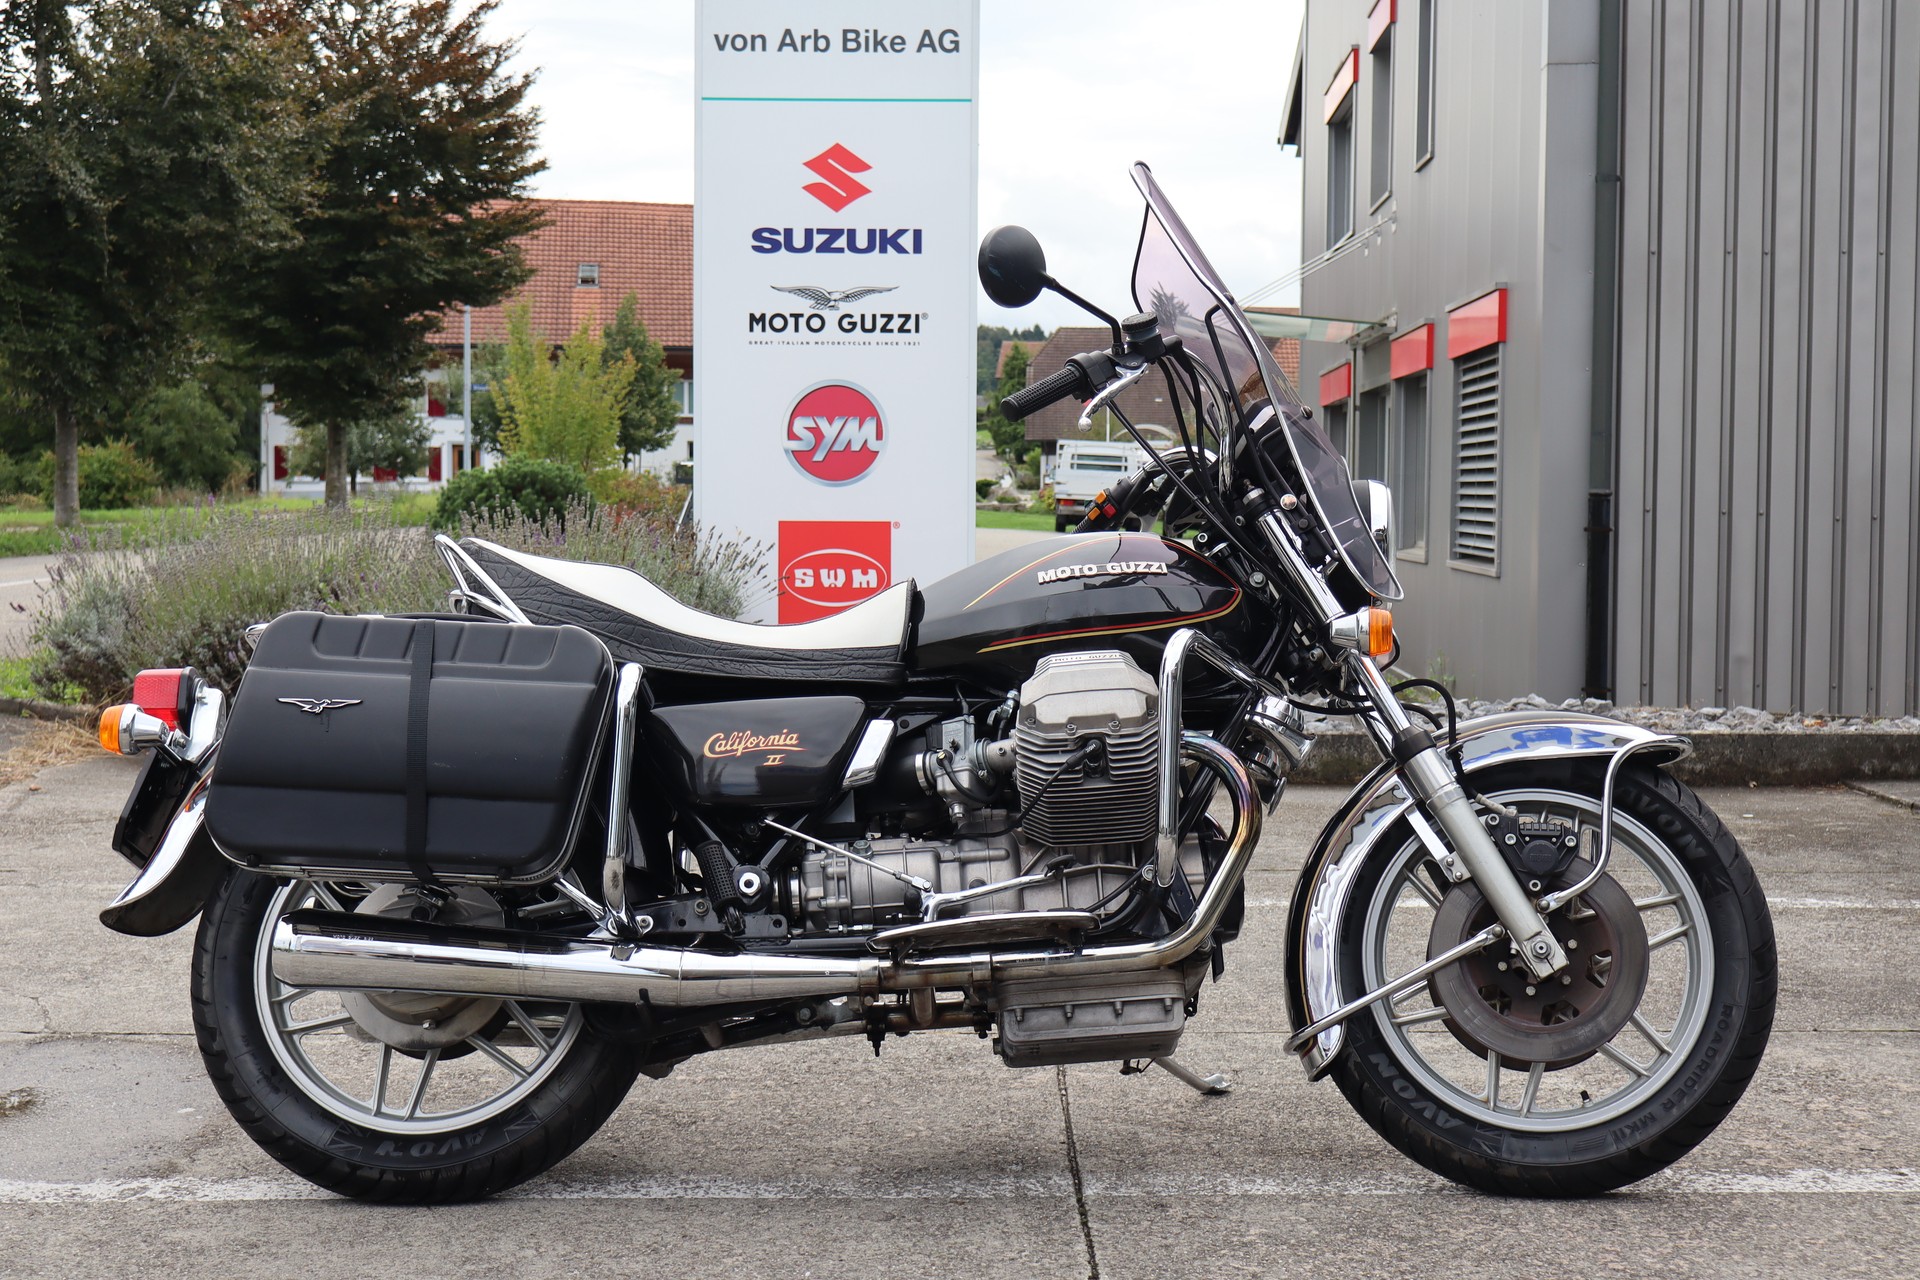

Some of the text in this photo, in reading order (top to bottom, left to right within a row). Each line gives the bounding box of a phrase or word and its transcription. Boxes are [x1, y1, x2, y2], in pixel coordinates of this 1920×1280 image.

[713, 28, 960, 54] von Arb Bike AG
[750, 226, 923, 255] SUZUKI
[748, 312, 921, 334] MOTO GUZZI
[784, 415, 884, 462] SYM
[793, 567, 879, 589] SWM
[1036, 561, 1169, 585] MOTO GUZZI
[703, 728, 807, 759] California
[762, 753, 787, 767] II
[1611, 1003, 1735, 1144] ROADRIDER MKII
[1367, 1052, 1466, 1130] AVON
[373, 1126, 490, 1158] AVON
